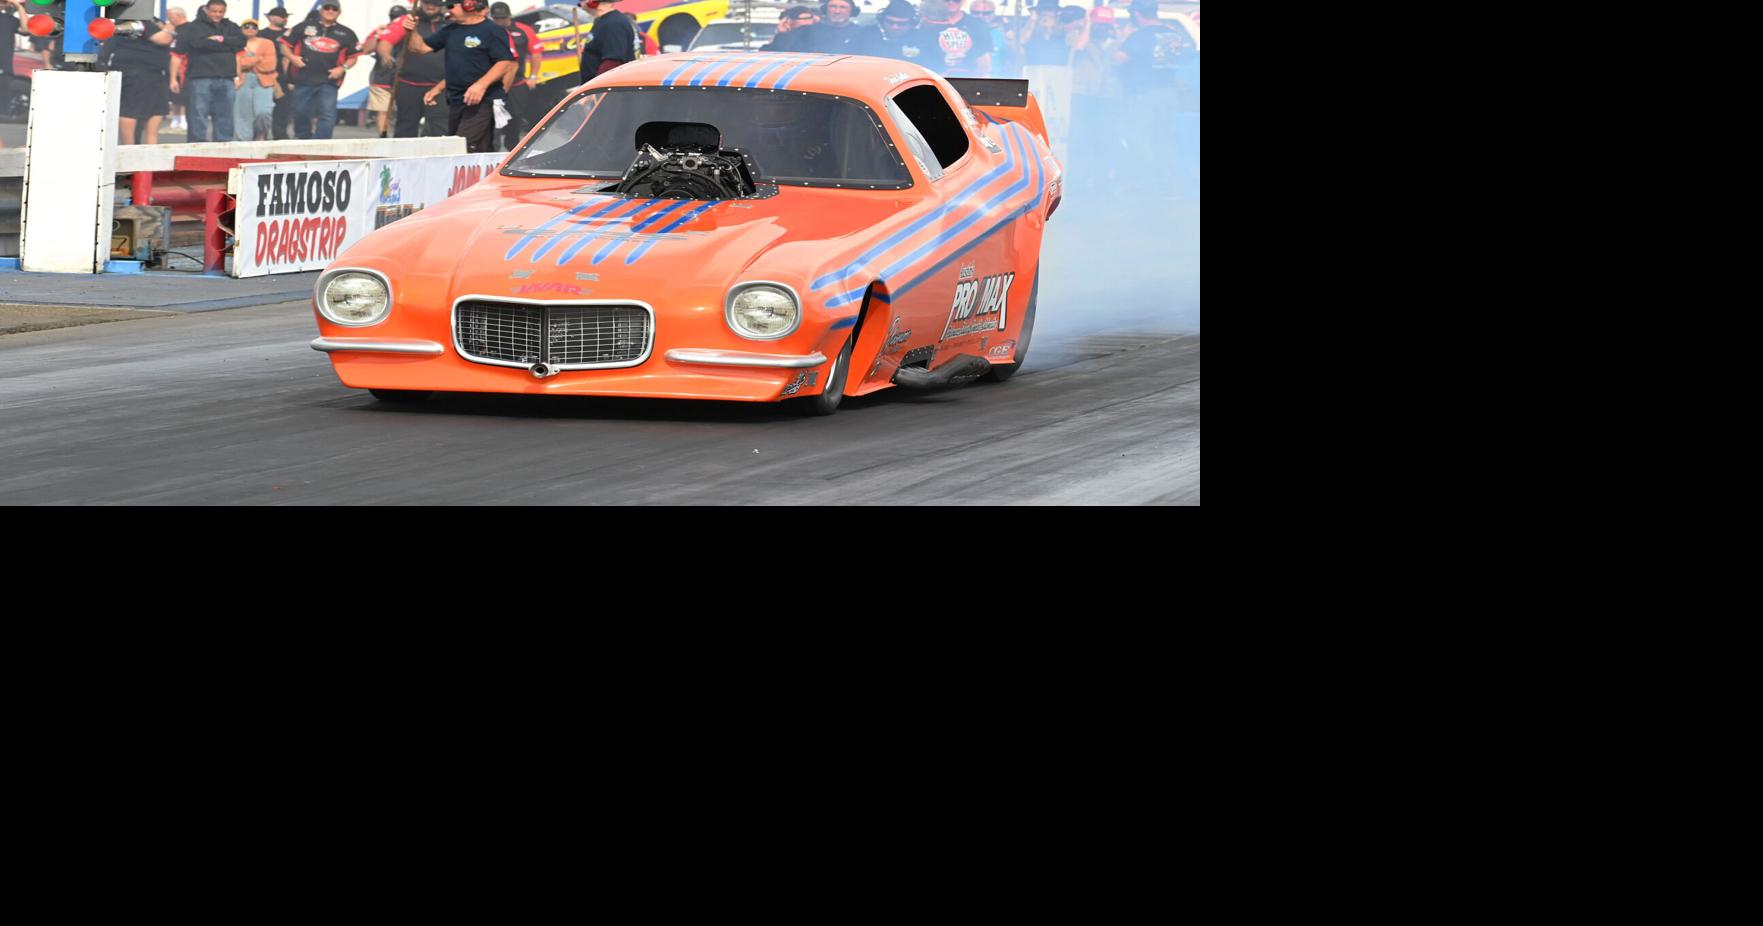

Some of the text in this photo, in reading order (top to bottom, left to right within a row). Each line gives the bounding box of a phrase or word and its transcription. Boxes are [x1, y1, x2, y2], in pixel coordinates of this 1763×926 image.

[256, 169, 352, 217] FAMOSO
[254, 215, 347, 268] DRAGSTRIP
[939, 278, 979, 342] PRO
[976, 271, 1015, 331] MAX
